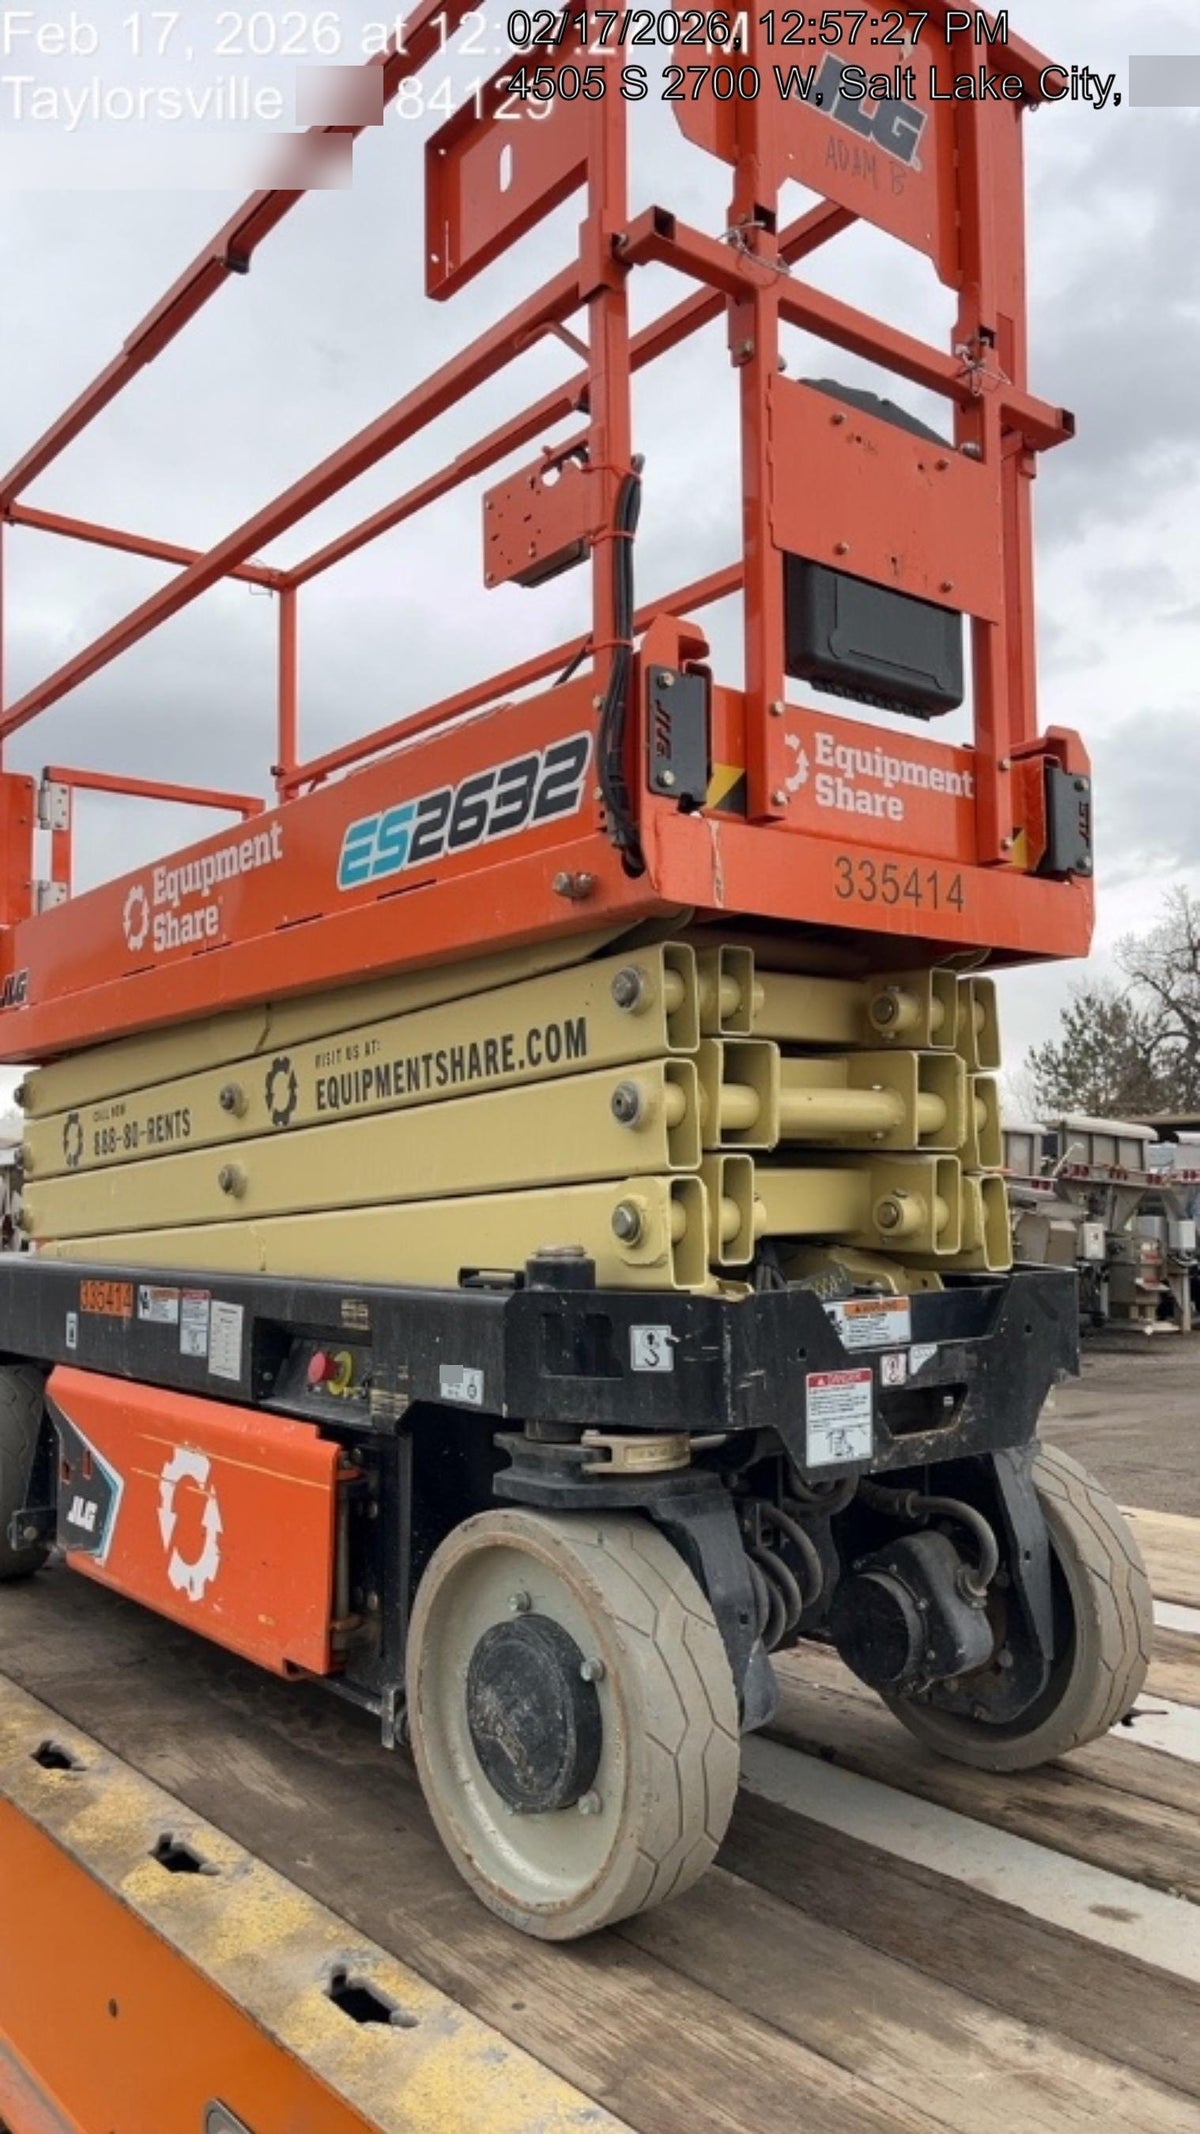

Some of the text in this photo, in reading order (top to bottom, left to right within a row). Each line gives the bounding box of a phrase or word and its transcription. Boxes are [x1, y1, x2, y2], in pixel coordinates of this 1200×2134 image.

[814, 732, 974, 799] Equipment
[336, 731, 592, 890] ES2632
[814, 775, 905, 822] Share
[153, 820, 283, 908] Equipment
[834, 856, 964, 913] 335414
[153, 904, 219, 953] Share
[316, 1017, 588, 1111] EQUIPMENTSHARE.COM
[94, 1107, 190, 1156] 888-80-RENTS
[68, 1496, 98, 1532] JLG
